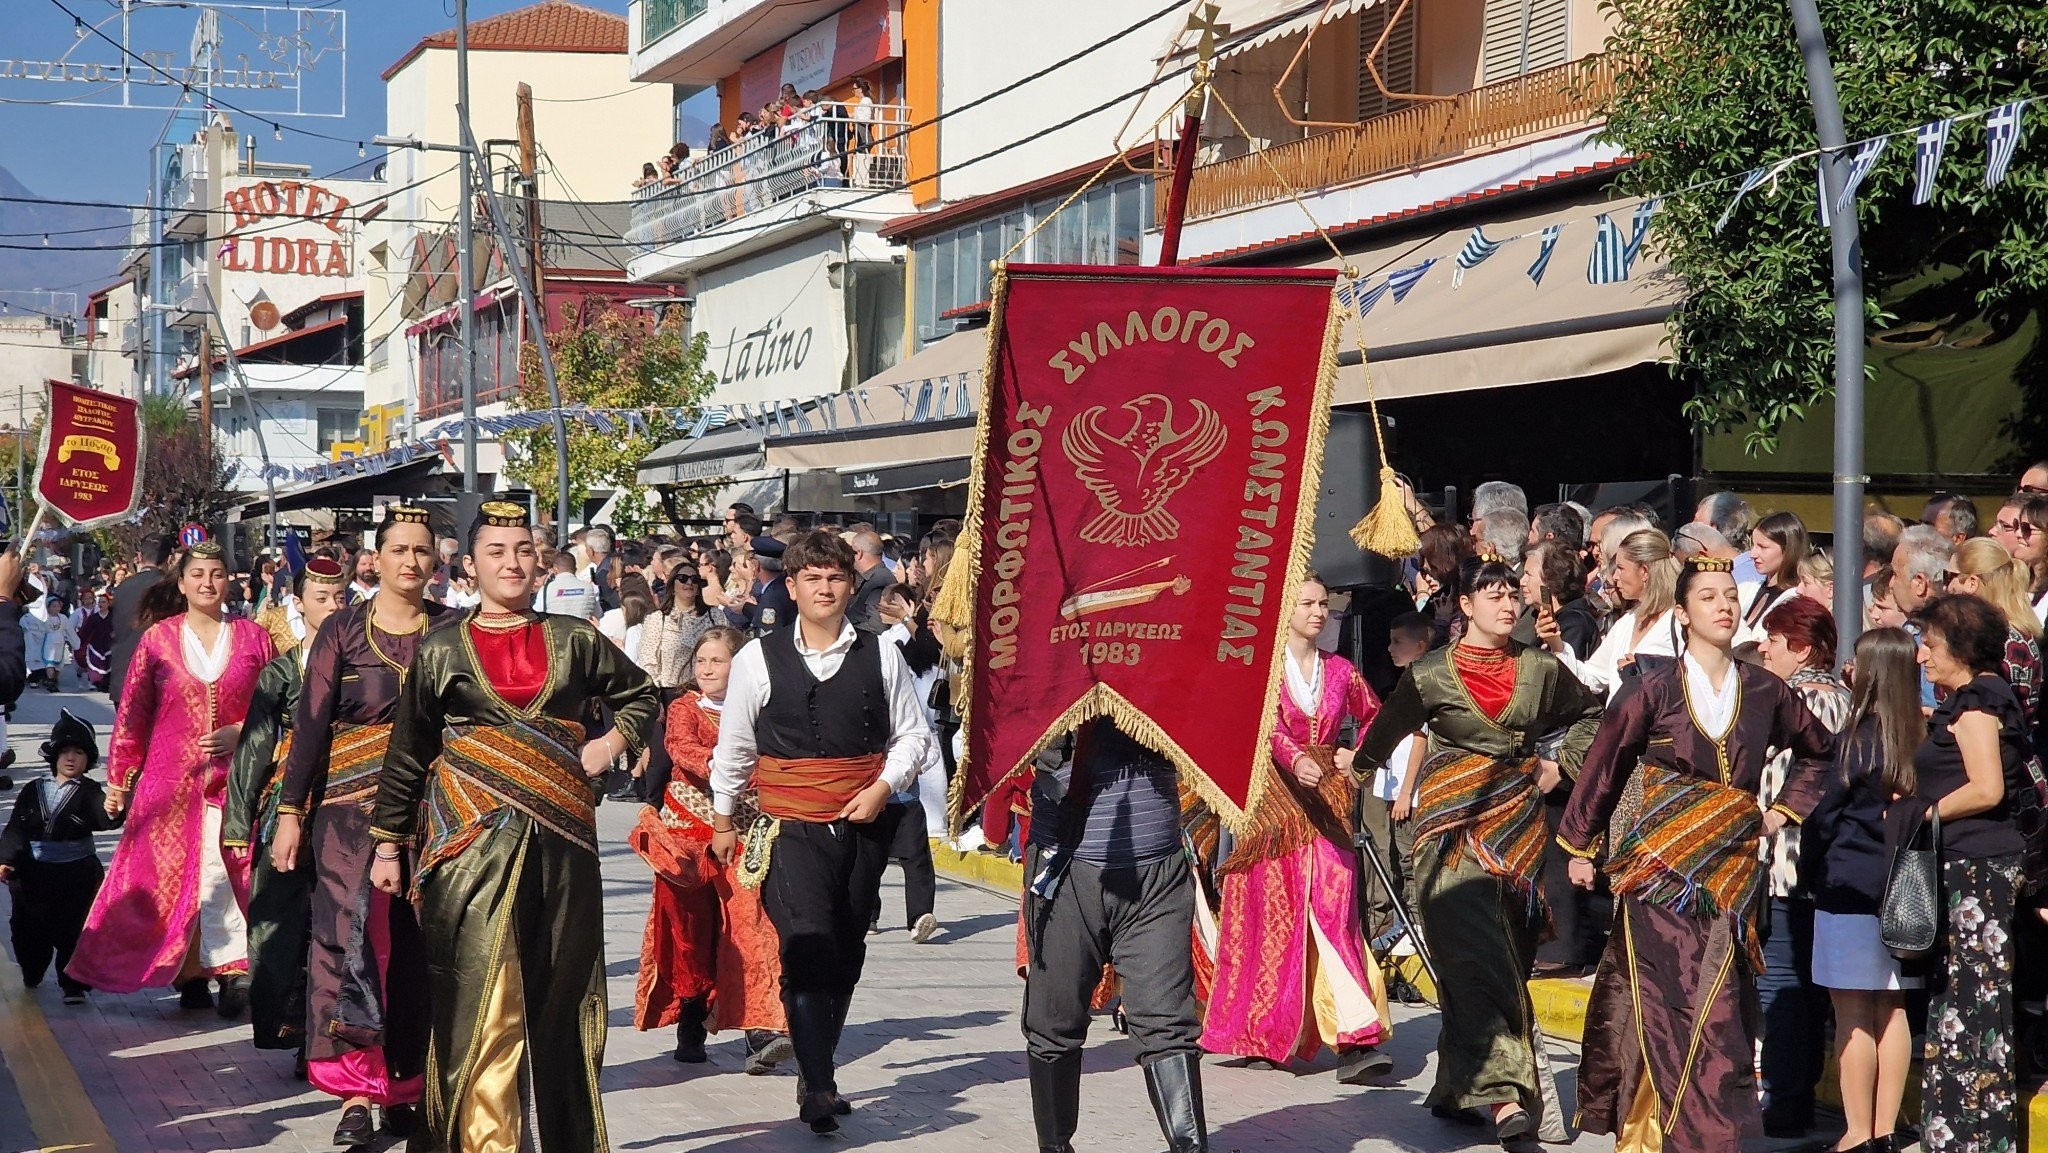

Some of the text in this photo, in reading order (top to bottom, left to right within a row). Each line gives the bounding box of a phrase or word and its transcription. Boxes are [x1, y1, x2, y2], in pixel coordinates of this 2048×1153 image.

[789, 38, 825, 72] WISDOM
[225, 180, 350, 237] HOTEL
[222, 234, 348, 278] LIDRA
[720, 316, 813, 385] Latino
[1048, 306, 1255, 384] ΣΥΛΛΟΓΟΣ
[60, 477, 109, 493] ΙΔΡΥΣΕΩΣ
[72, 467, 100, 479] ΕΤΟΣ
[73, 491, 93, 501] 1983
[988, 401, 1053, 670] ΜΟΡΦΩΤΙΚΟΣ
[1216, 385, 1290, 666] ΚΩΝΣΤΑΝΤΙΑΣ
[1050, 621, 1183, 644] ΕΤΟΣ ΙΔΡΥΣΕΩΣ
[1079, 642, 1141, 666] 1983
